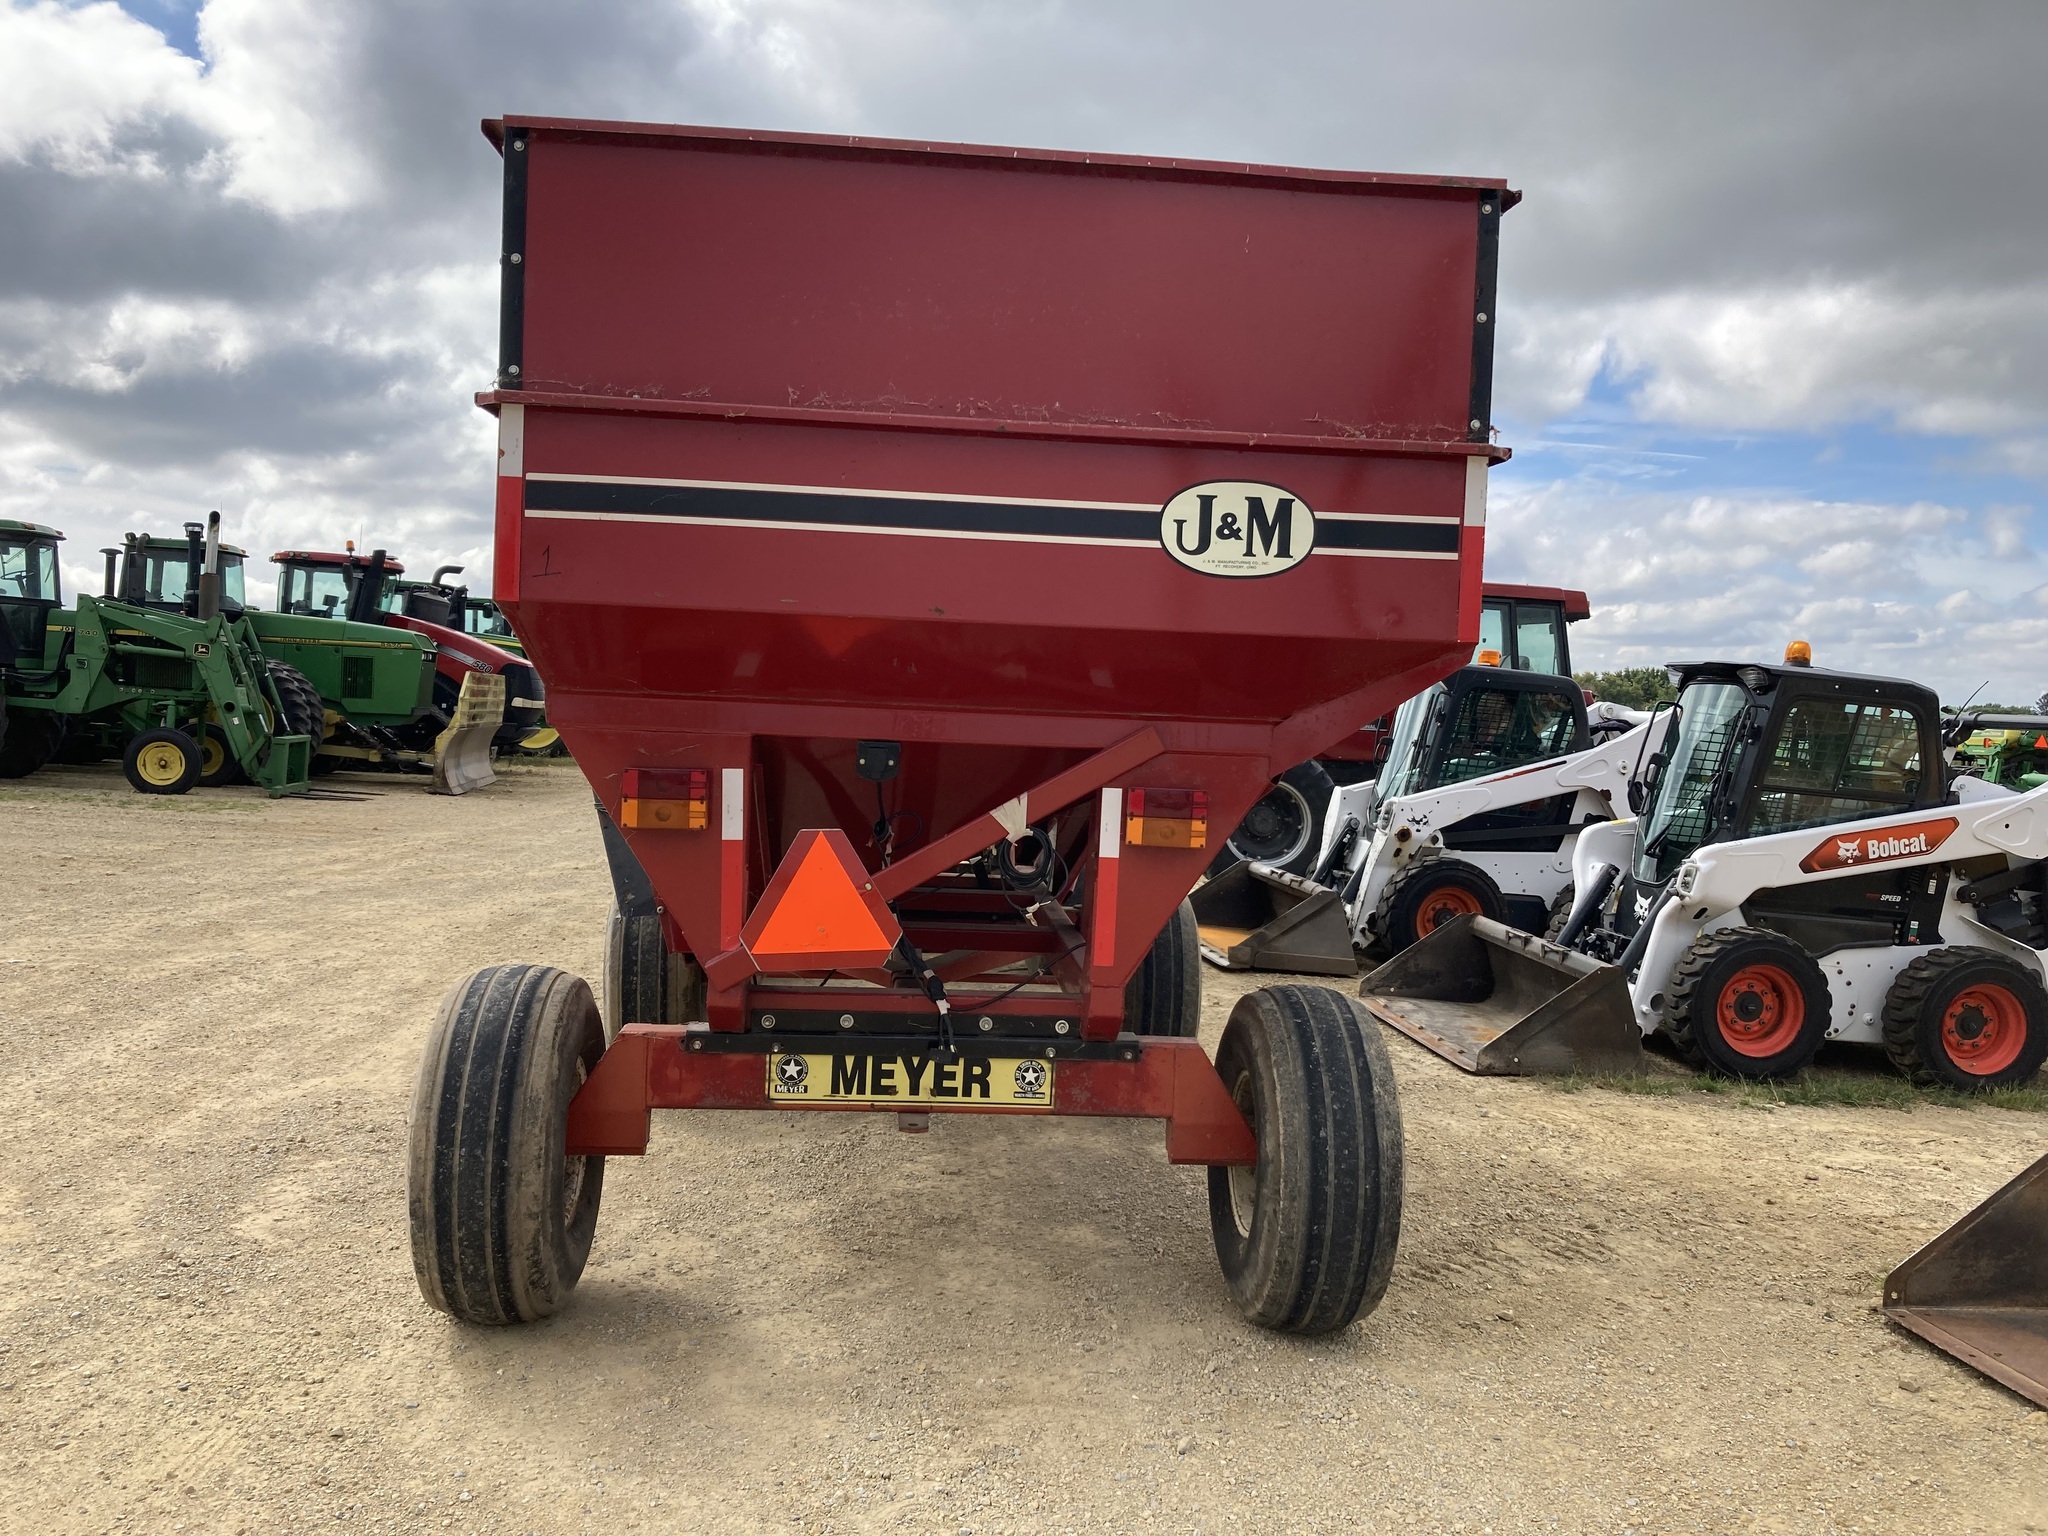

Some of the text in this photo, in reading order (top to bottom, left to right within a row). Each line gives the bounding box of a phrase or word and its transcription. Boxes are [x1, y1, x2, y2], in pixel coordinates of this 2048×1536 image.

[1173, 494, 1296, 559] J&M
[472, 659, 494, 674] 580
[1867, 833, 1926, 859] Bobcat
[777, 1085, 804, 1093] MEYER
[830, 1055, 991, 1097] MEYER
